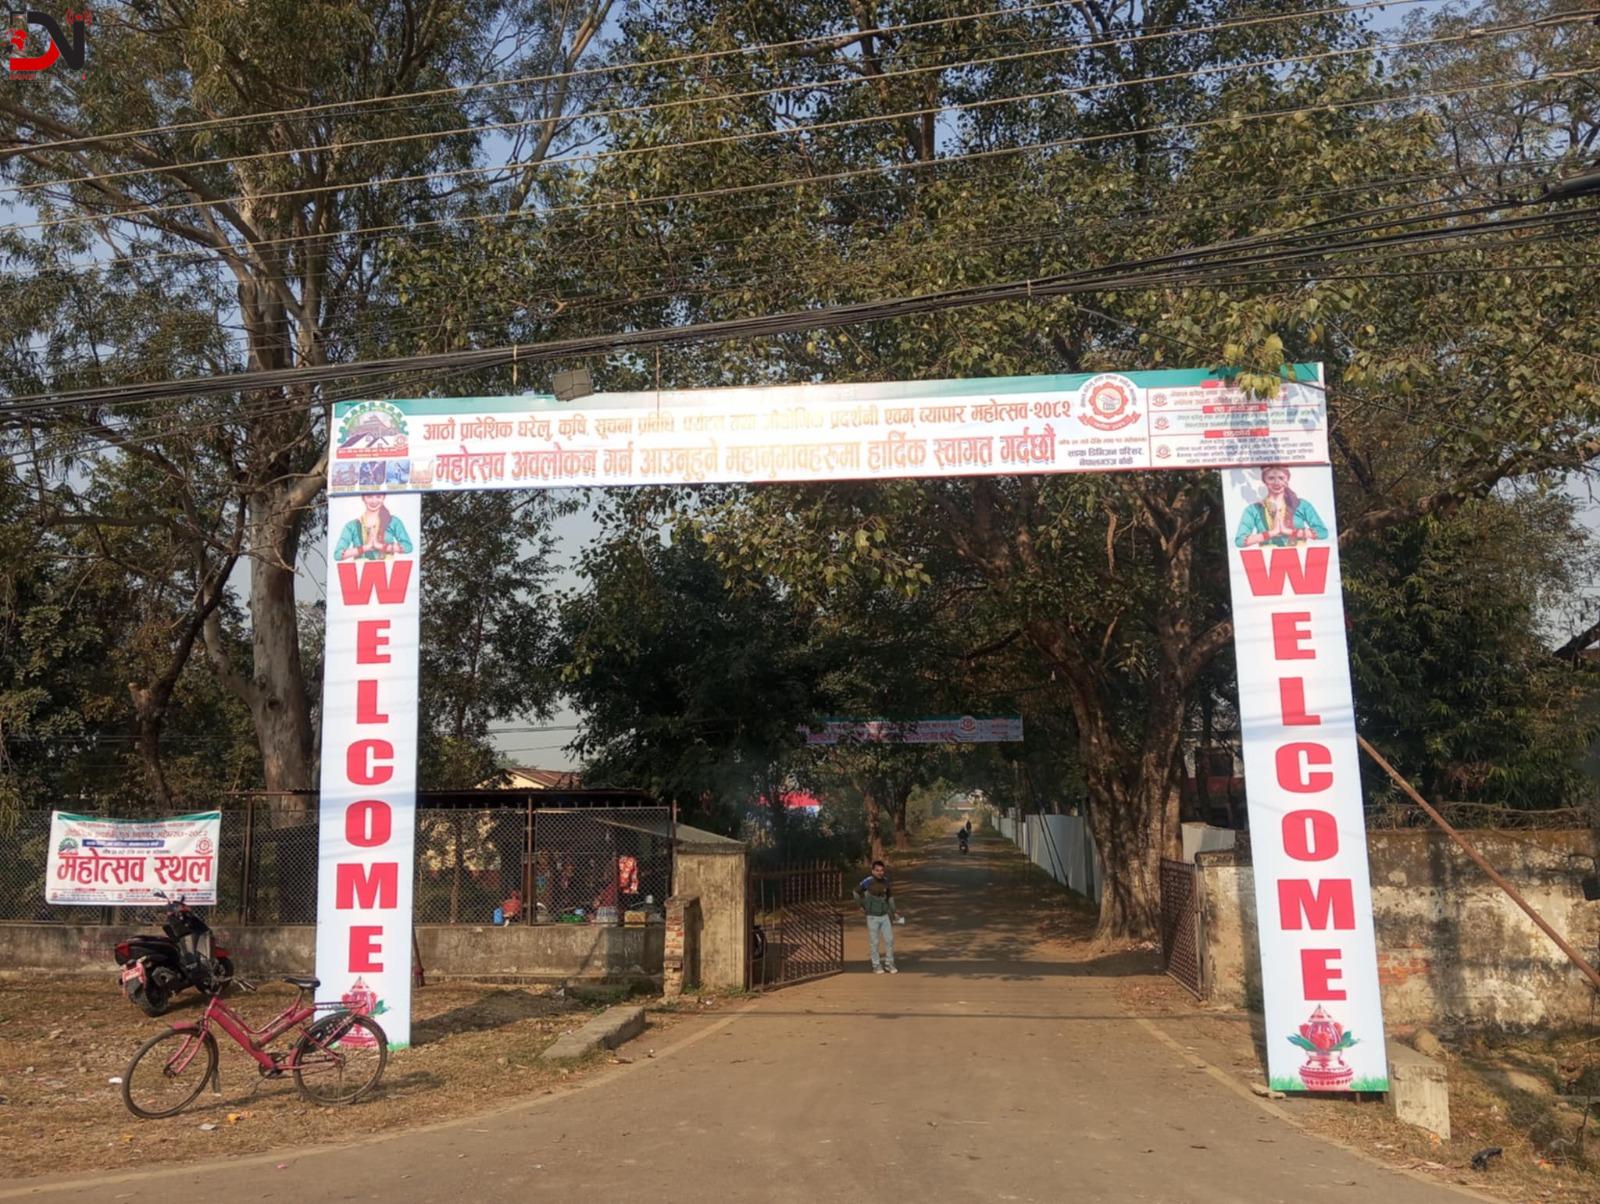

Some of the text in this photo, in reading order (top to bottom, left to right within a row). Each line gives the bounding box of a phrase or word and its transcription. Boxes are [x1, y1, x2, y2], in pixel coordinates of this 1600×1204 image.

[460, 415, 513, 442] प्रादेशिक
[594, 417, 633, 440] सूचना
[830, 403, 879, 429] प्रदर्शनी
[920, 404, 966, 424] व्यापार
[435, 445, 506, 485] महोत्सव
[512, 441, 597, 481] अवलोकन
[604, 440, 634, 477] गर्न
[640, 437, 720, 482] आउनुहुने
[867, 430, 927, 472] हार्दिक
[933, 436, 993, 469] स्वागत
[335, 560, 414, 974] WELCOME
[1239, 546, 1356, 1002] WELCOME
[57, 847, 214, 885] महोत्सव स्थल
